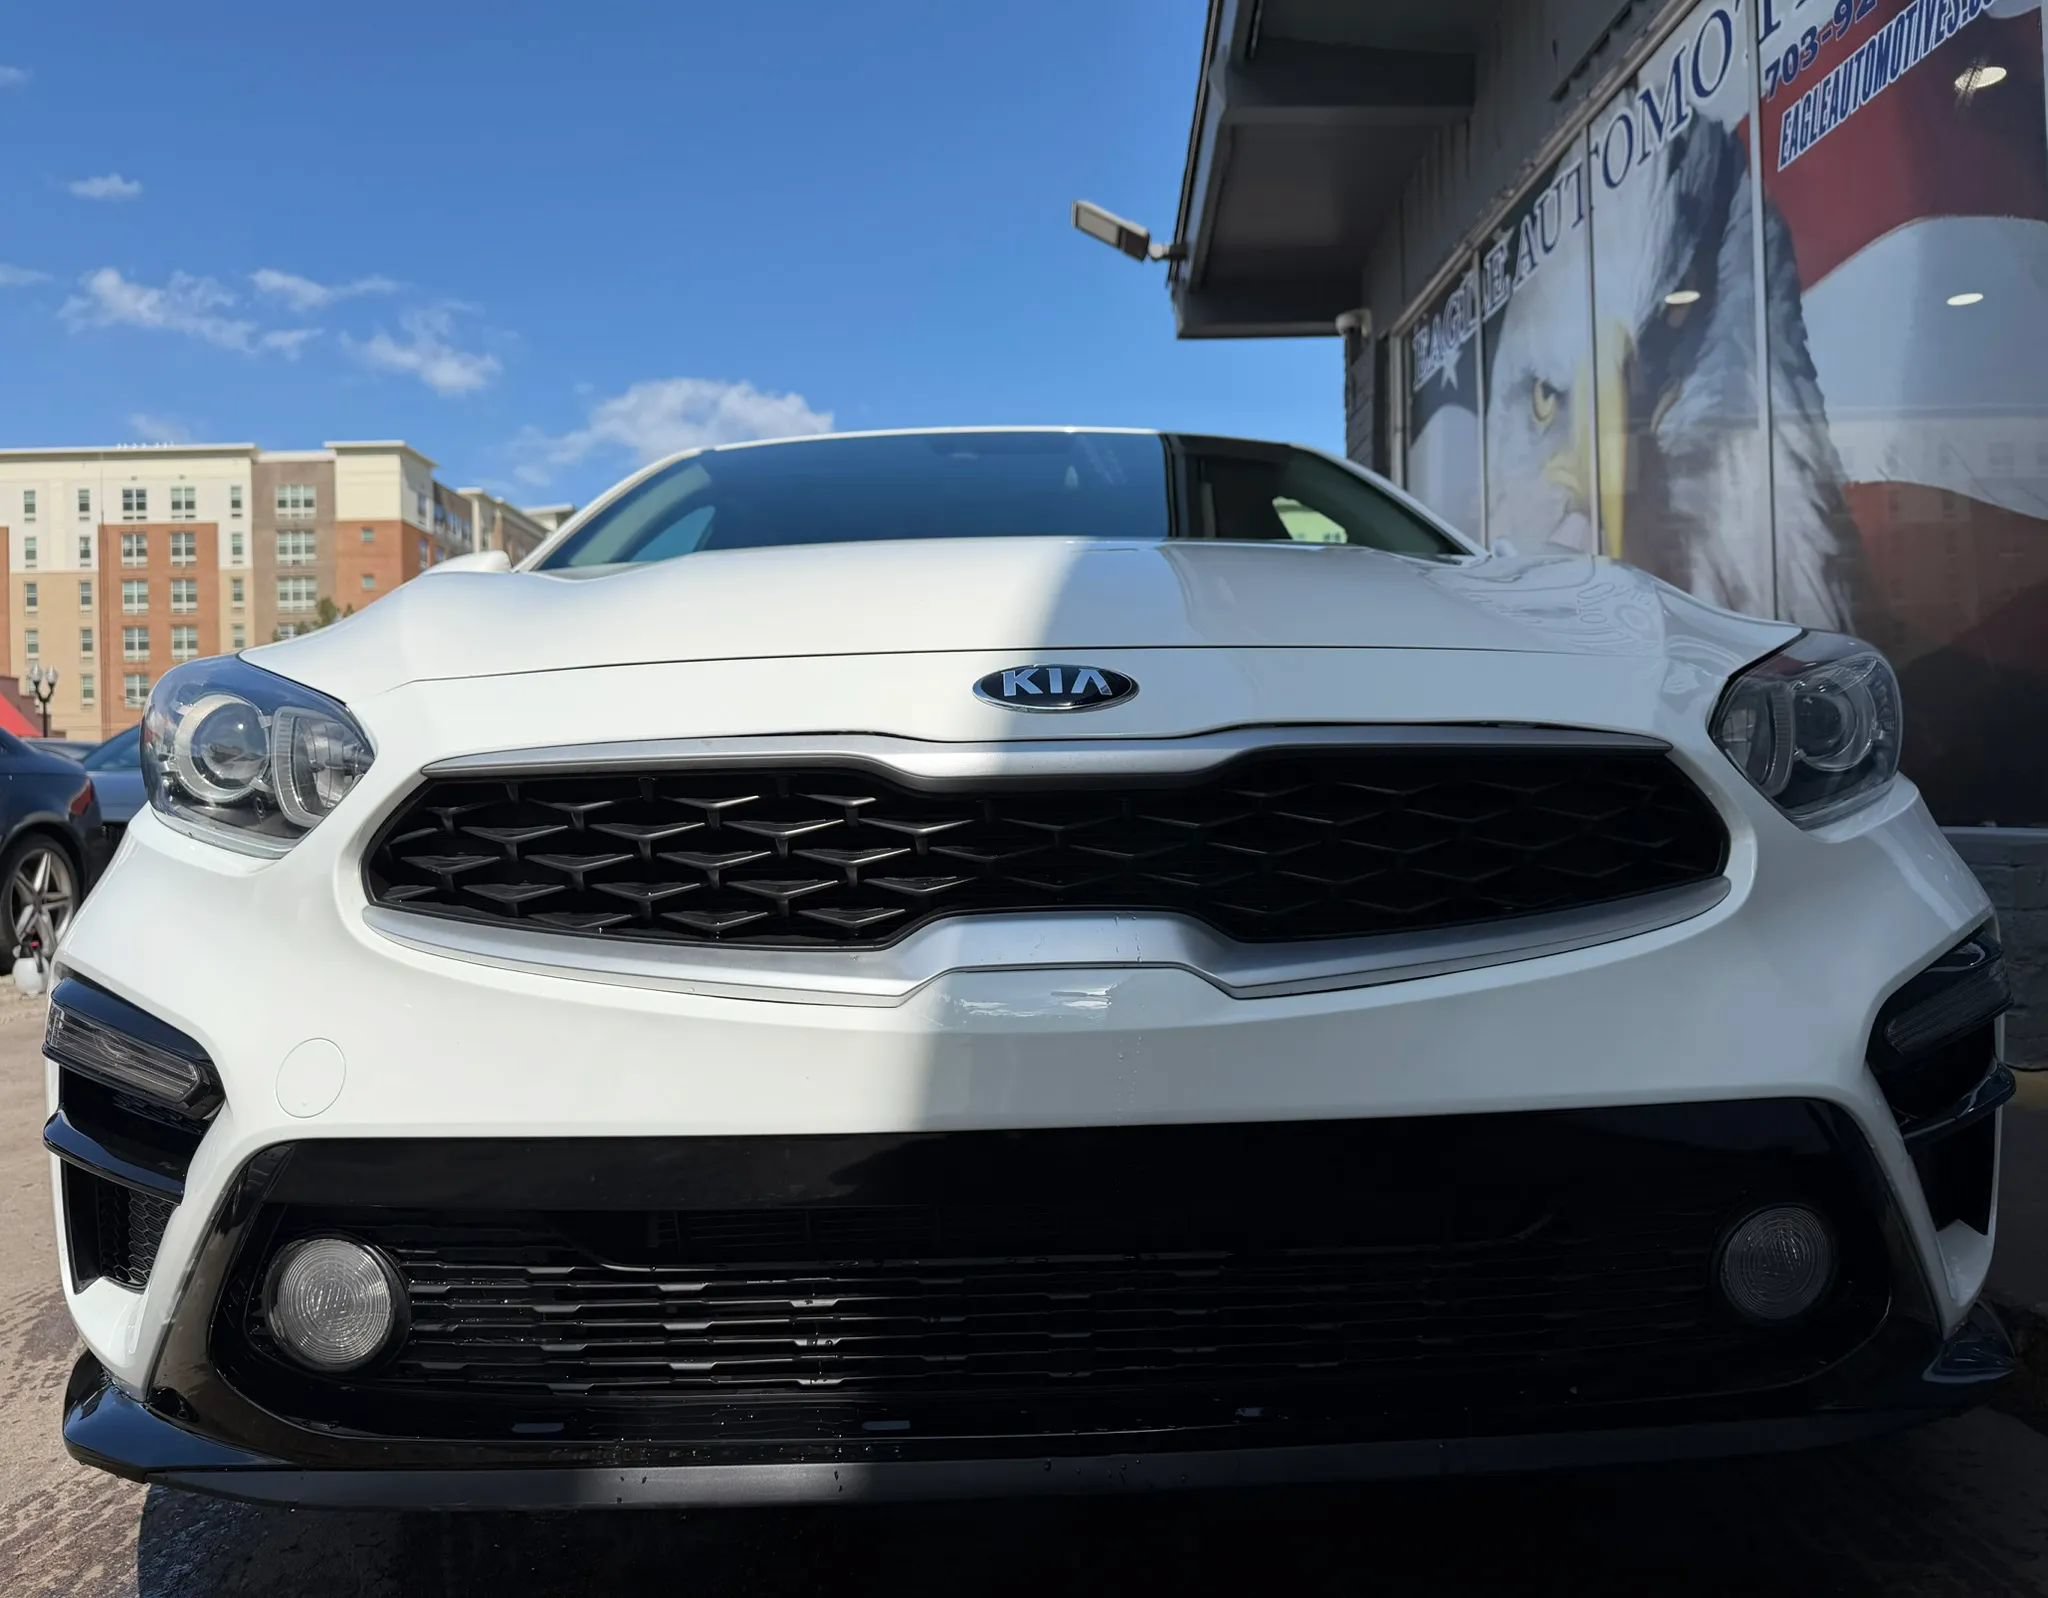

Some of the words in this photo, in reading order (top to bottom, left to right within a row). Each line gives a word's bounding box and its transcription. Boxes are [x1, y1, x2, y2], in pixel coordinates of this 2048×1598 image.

[1778, 0, 1994, 172] EAGLEAUTOMOTIVES.
[1413, 245, 1513, 391] EAGLE
[1513, 0, 1808, 293] AUTOMO
[1001, 667, 1113, 697] KIA
